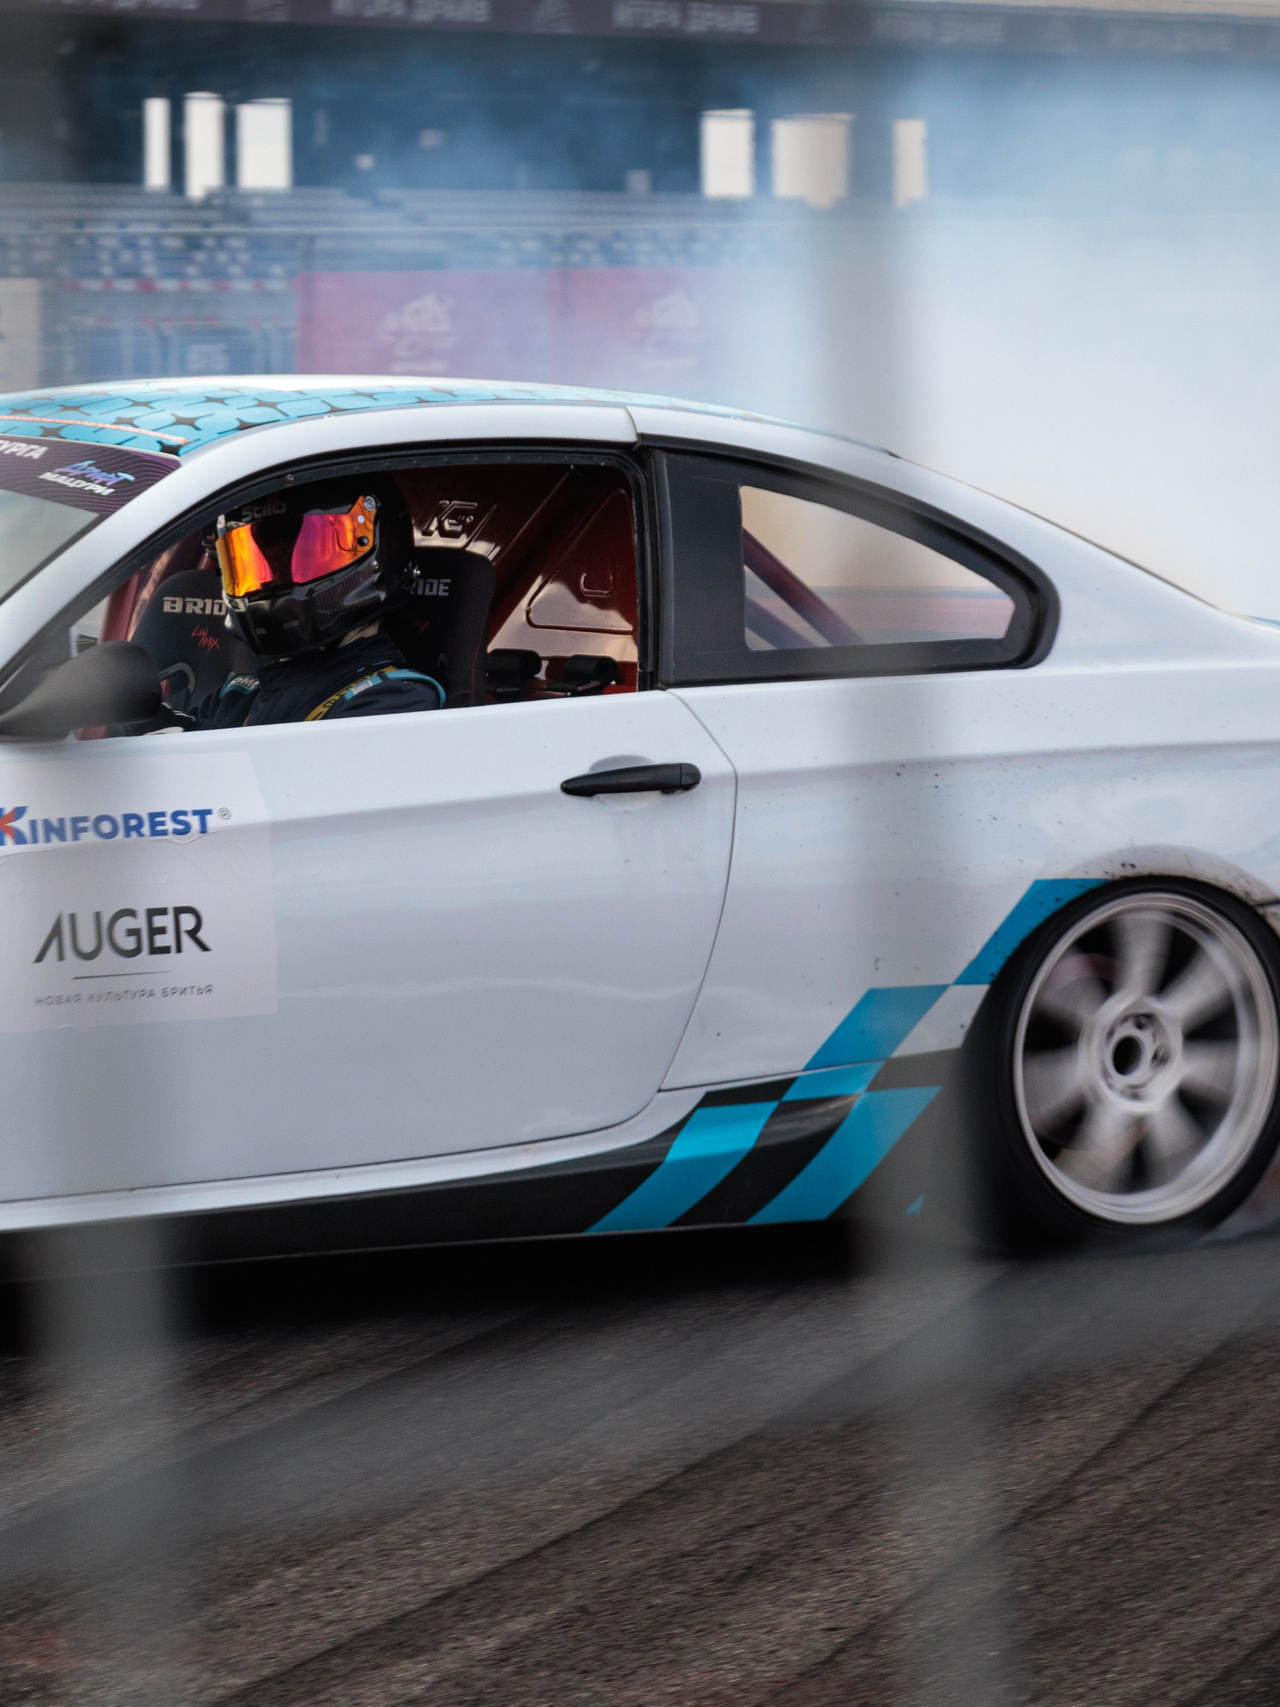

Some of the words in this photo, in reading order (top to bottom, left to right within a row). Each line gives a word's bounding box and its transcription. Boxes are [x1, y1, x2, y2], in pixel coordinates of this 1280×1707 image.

[38, 471, 116, 496] МАЦУРИ
[32, 905, 212, 964] AUGER
[86, 988, 156, 1003] КУЛЬТУРА
[161, 983, 214, 998] БРИТЬЯ
